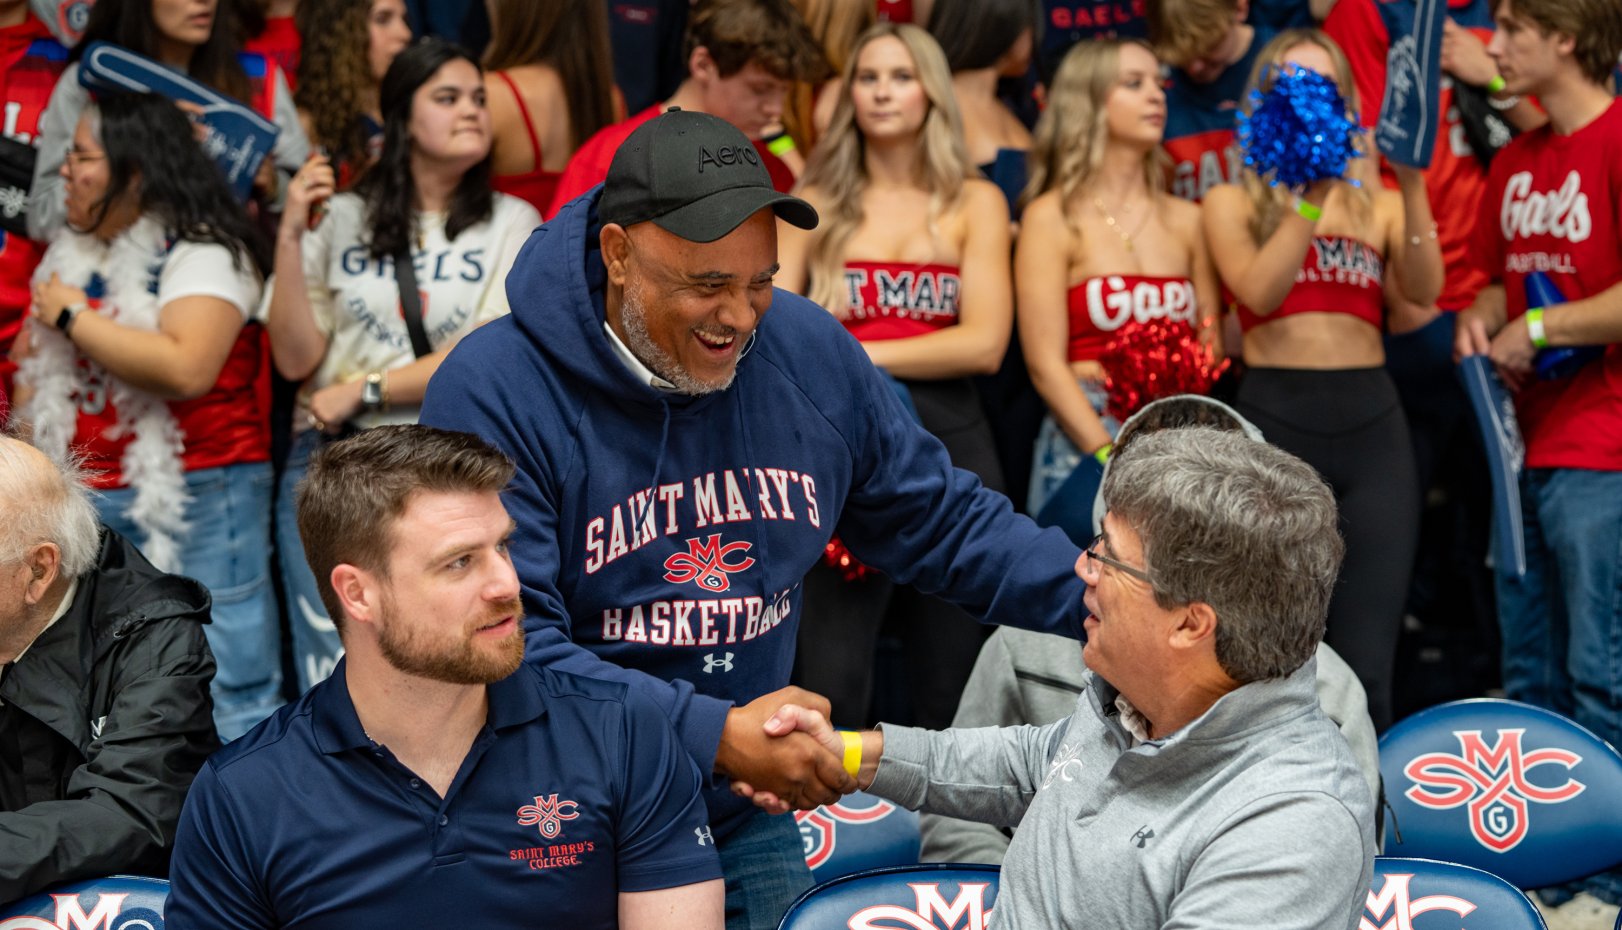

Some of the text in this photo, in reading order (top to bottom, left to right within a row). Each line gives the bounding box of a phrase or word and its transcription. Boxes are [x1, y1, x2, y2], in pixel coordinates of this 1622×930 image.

[698, 146, 758, 173] Aero
[1501, 170, 1591, 243] Gaels
[584, 467, 821, 576] SAINT MARY'S
[509, 840, 595, 861] SAINT MARY'S
[529, 854, 578, 870] COLLEGE
